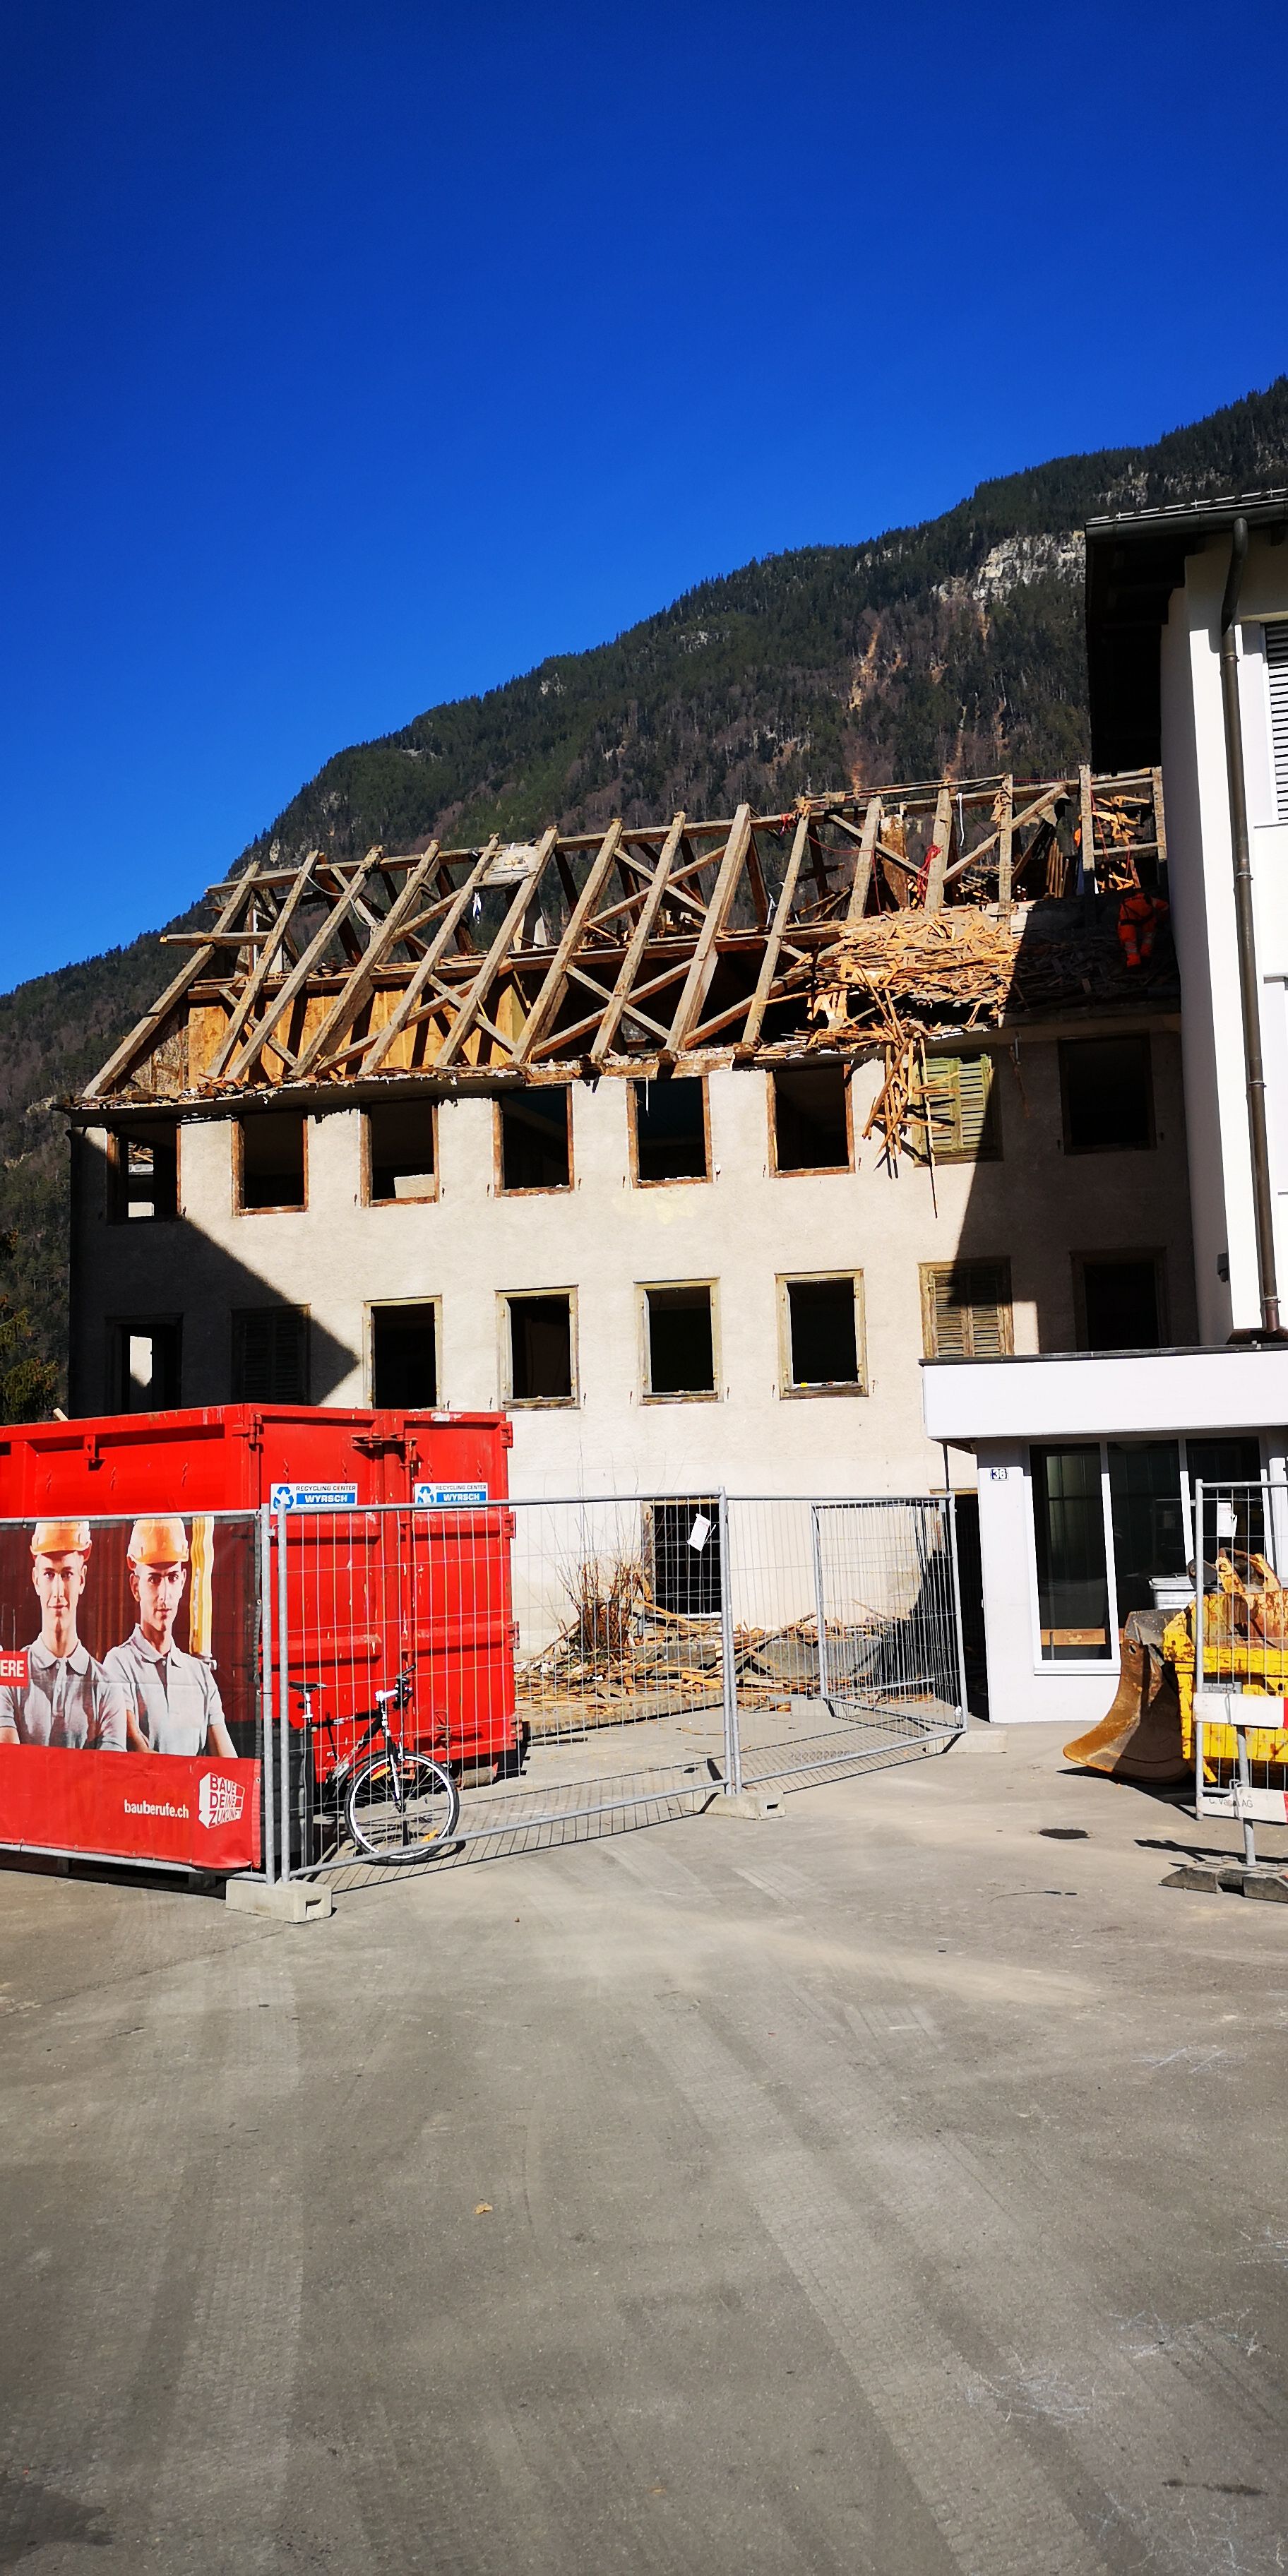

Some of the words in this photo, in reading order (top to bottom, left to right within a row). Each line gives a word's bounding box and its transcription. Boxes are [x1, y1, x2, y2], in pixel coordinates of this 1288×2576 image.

[304, 1494, 348, 1503] WYRSCH
[443, 1493, 480, 1501] WYRSCH
[210, 1773, 236, 1795] BAUE
[210, 1791, 235, 1808] DEINE
[124, 1799, 189, 1819] bauberufe.ch
